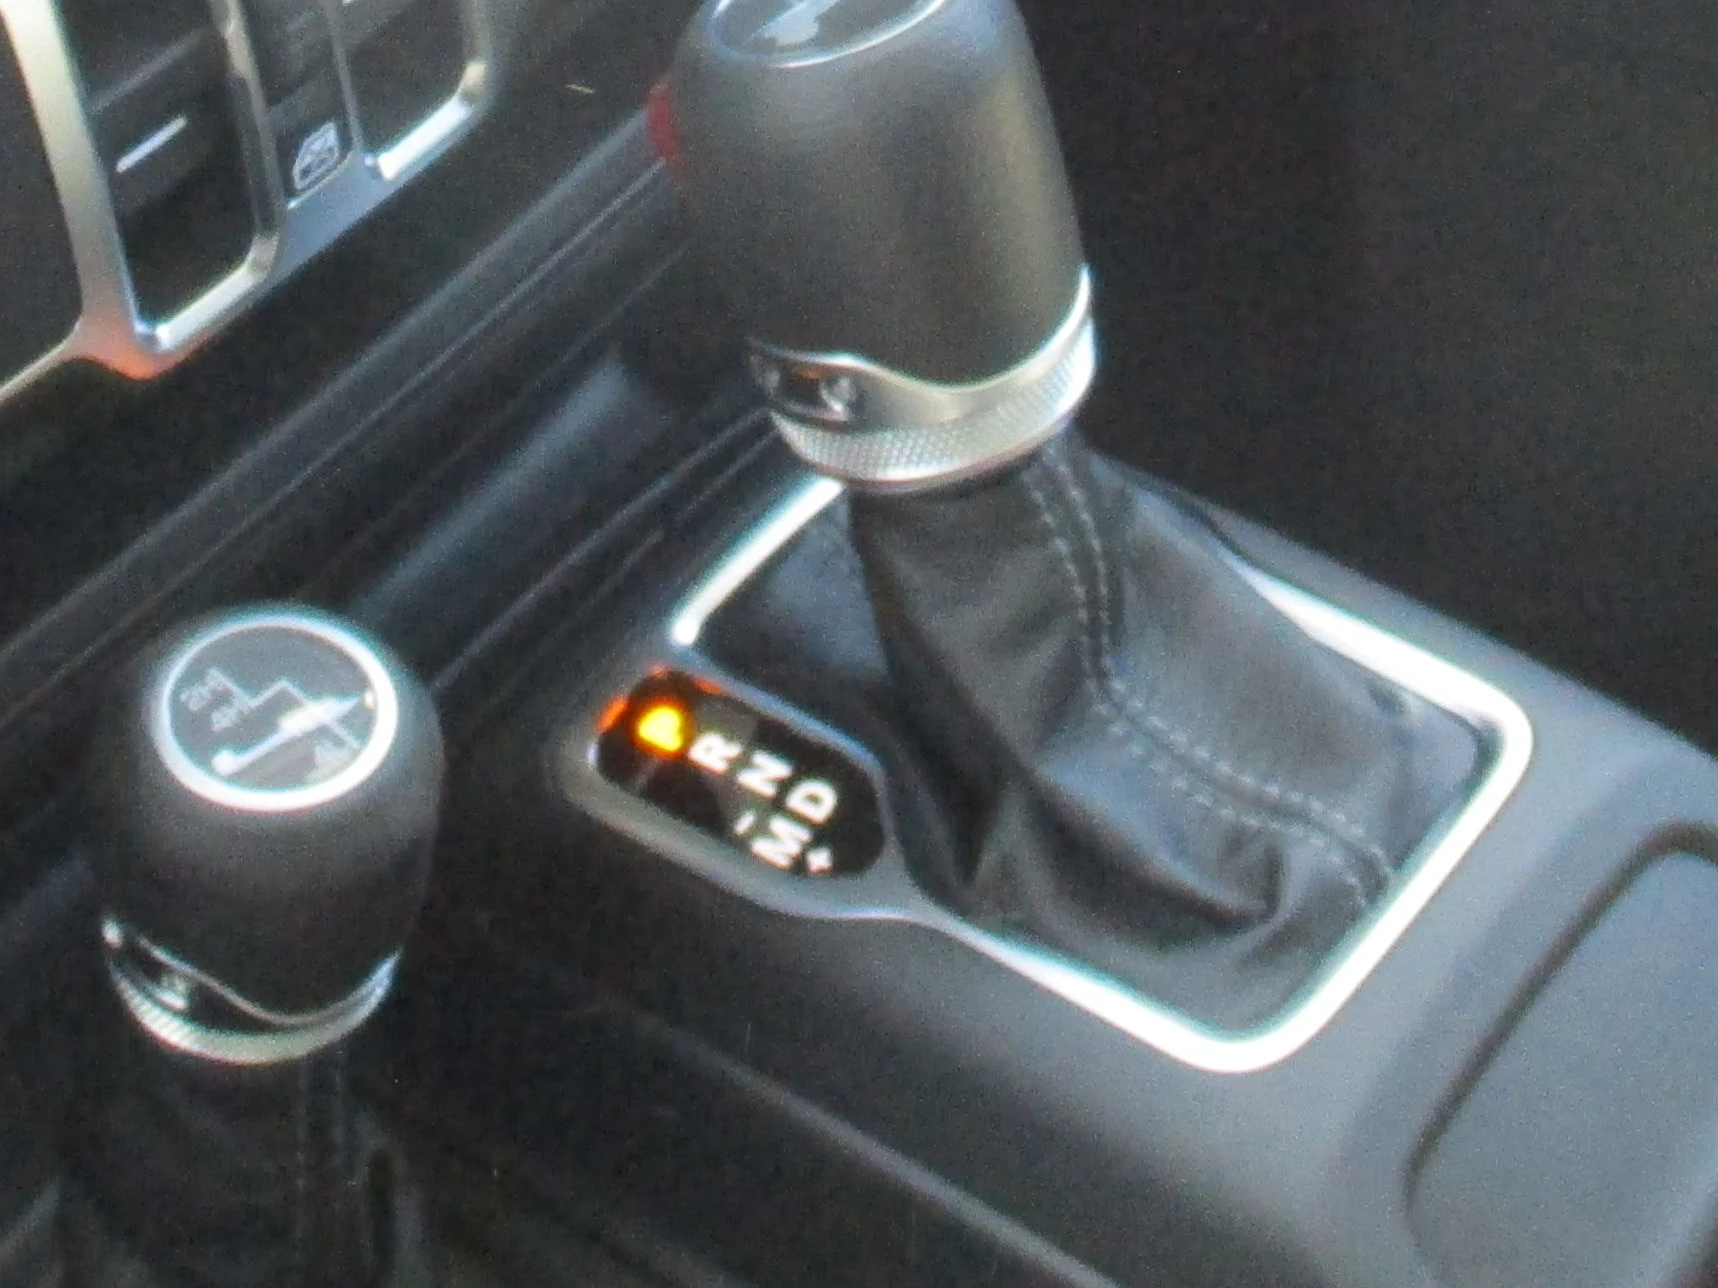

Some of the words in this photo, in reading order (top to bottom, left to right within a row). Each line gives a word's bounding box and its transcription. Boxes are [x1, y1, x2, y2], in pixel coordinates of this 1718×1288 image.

[687, 731, 743, 775] R
[735, 749, 794, 800] N
[785, 778, 838, 825] D
[750, 813, 814, 870] M
